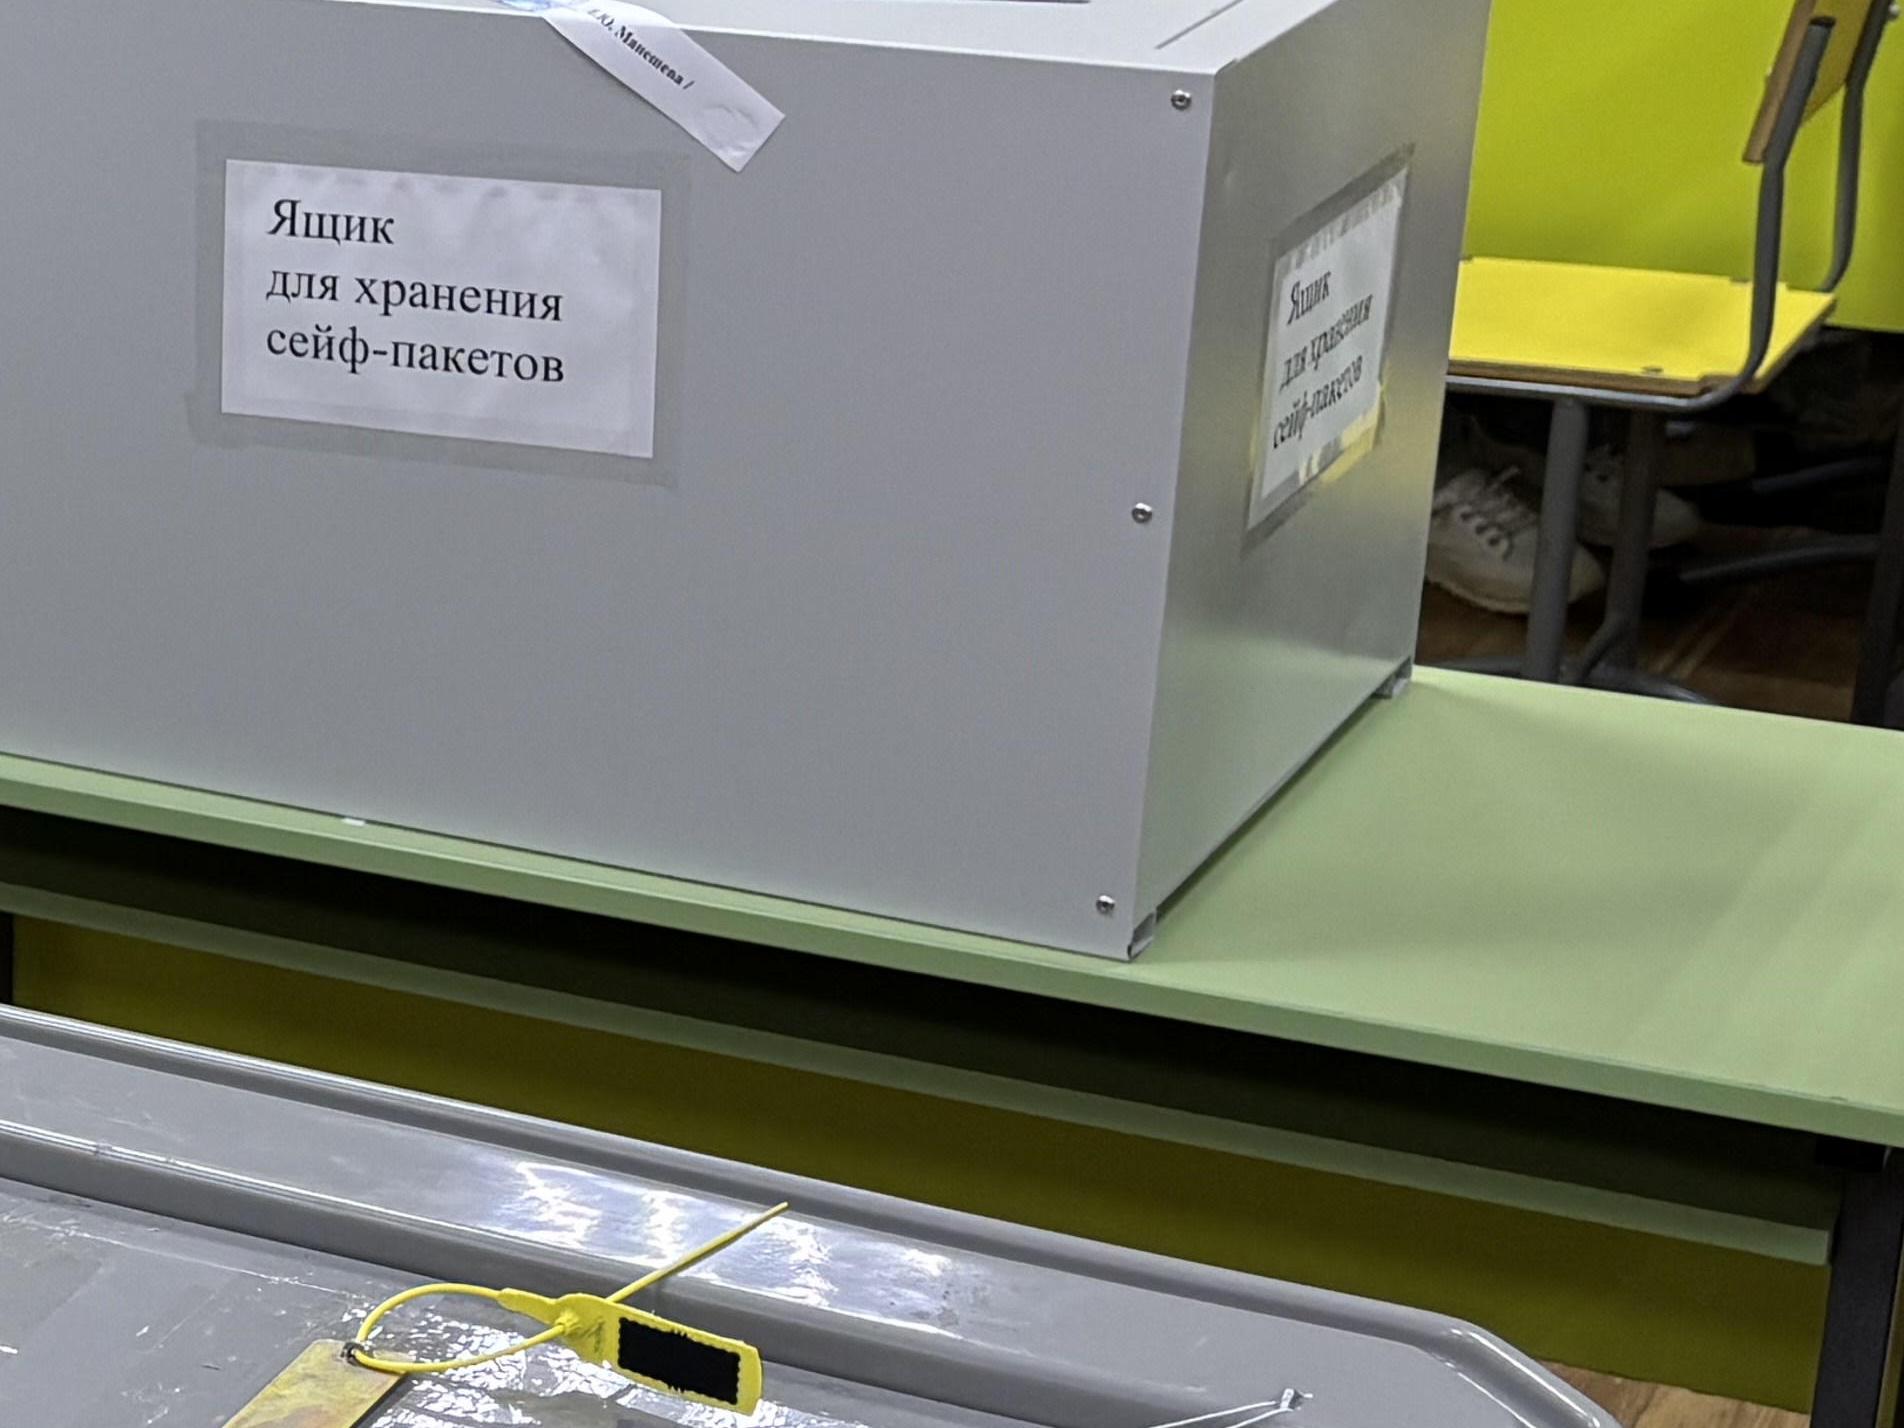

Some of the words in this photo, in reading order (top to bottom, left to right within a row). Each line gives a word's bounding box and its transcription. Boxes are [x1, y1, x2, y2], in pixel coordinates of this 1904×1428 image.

[266, 198, 395, 245] Ящик
[266, 270, 340, 304] для
[354, 277, 564, 322] хранения
[1287, 270, 1331, 325] Ящик
[266, 324, 565, 383] сейф-пакетов
[1279, 345, 1307, 393] для
[1309, 293, 1373, 371] хранения
[1273, 354, 1363, 449] сейф-пакетов
